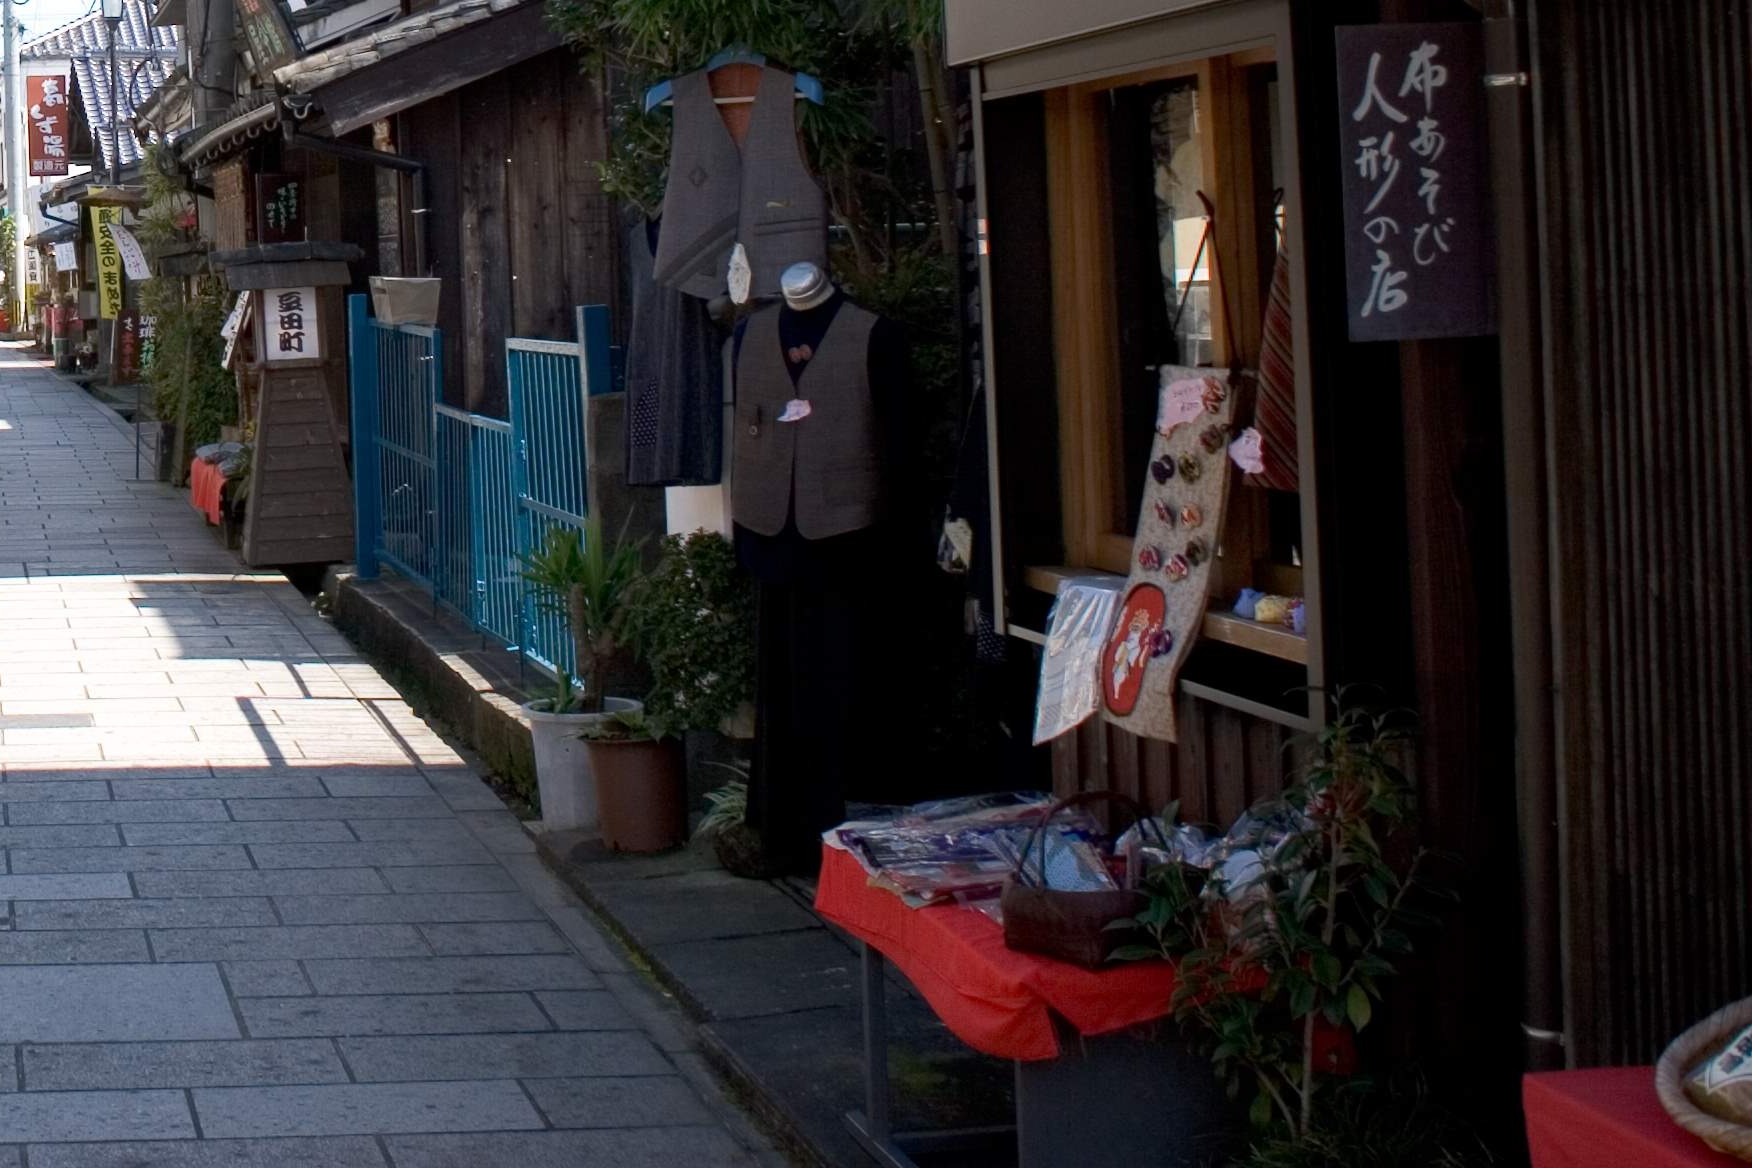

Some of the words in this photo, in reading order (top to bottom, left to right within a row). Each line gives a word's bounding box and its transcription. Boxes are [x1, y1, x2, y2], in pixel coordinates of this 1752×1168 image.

[1351, 51, 1408, 319] 人形の店
[1399, 39, 1450, 268] 布あそび
[277, 290, 306, 353] 豆田町
